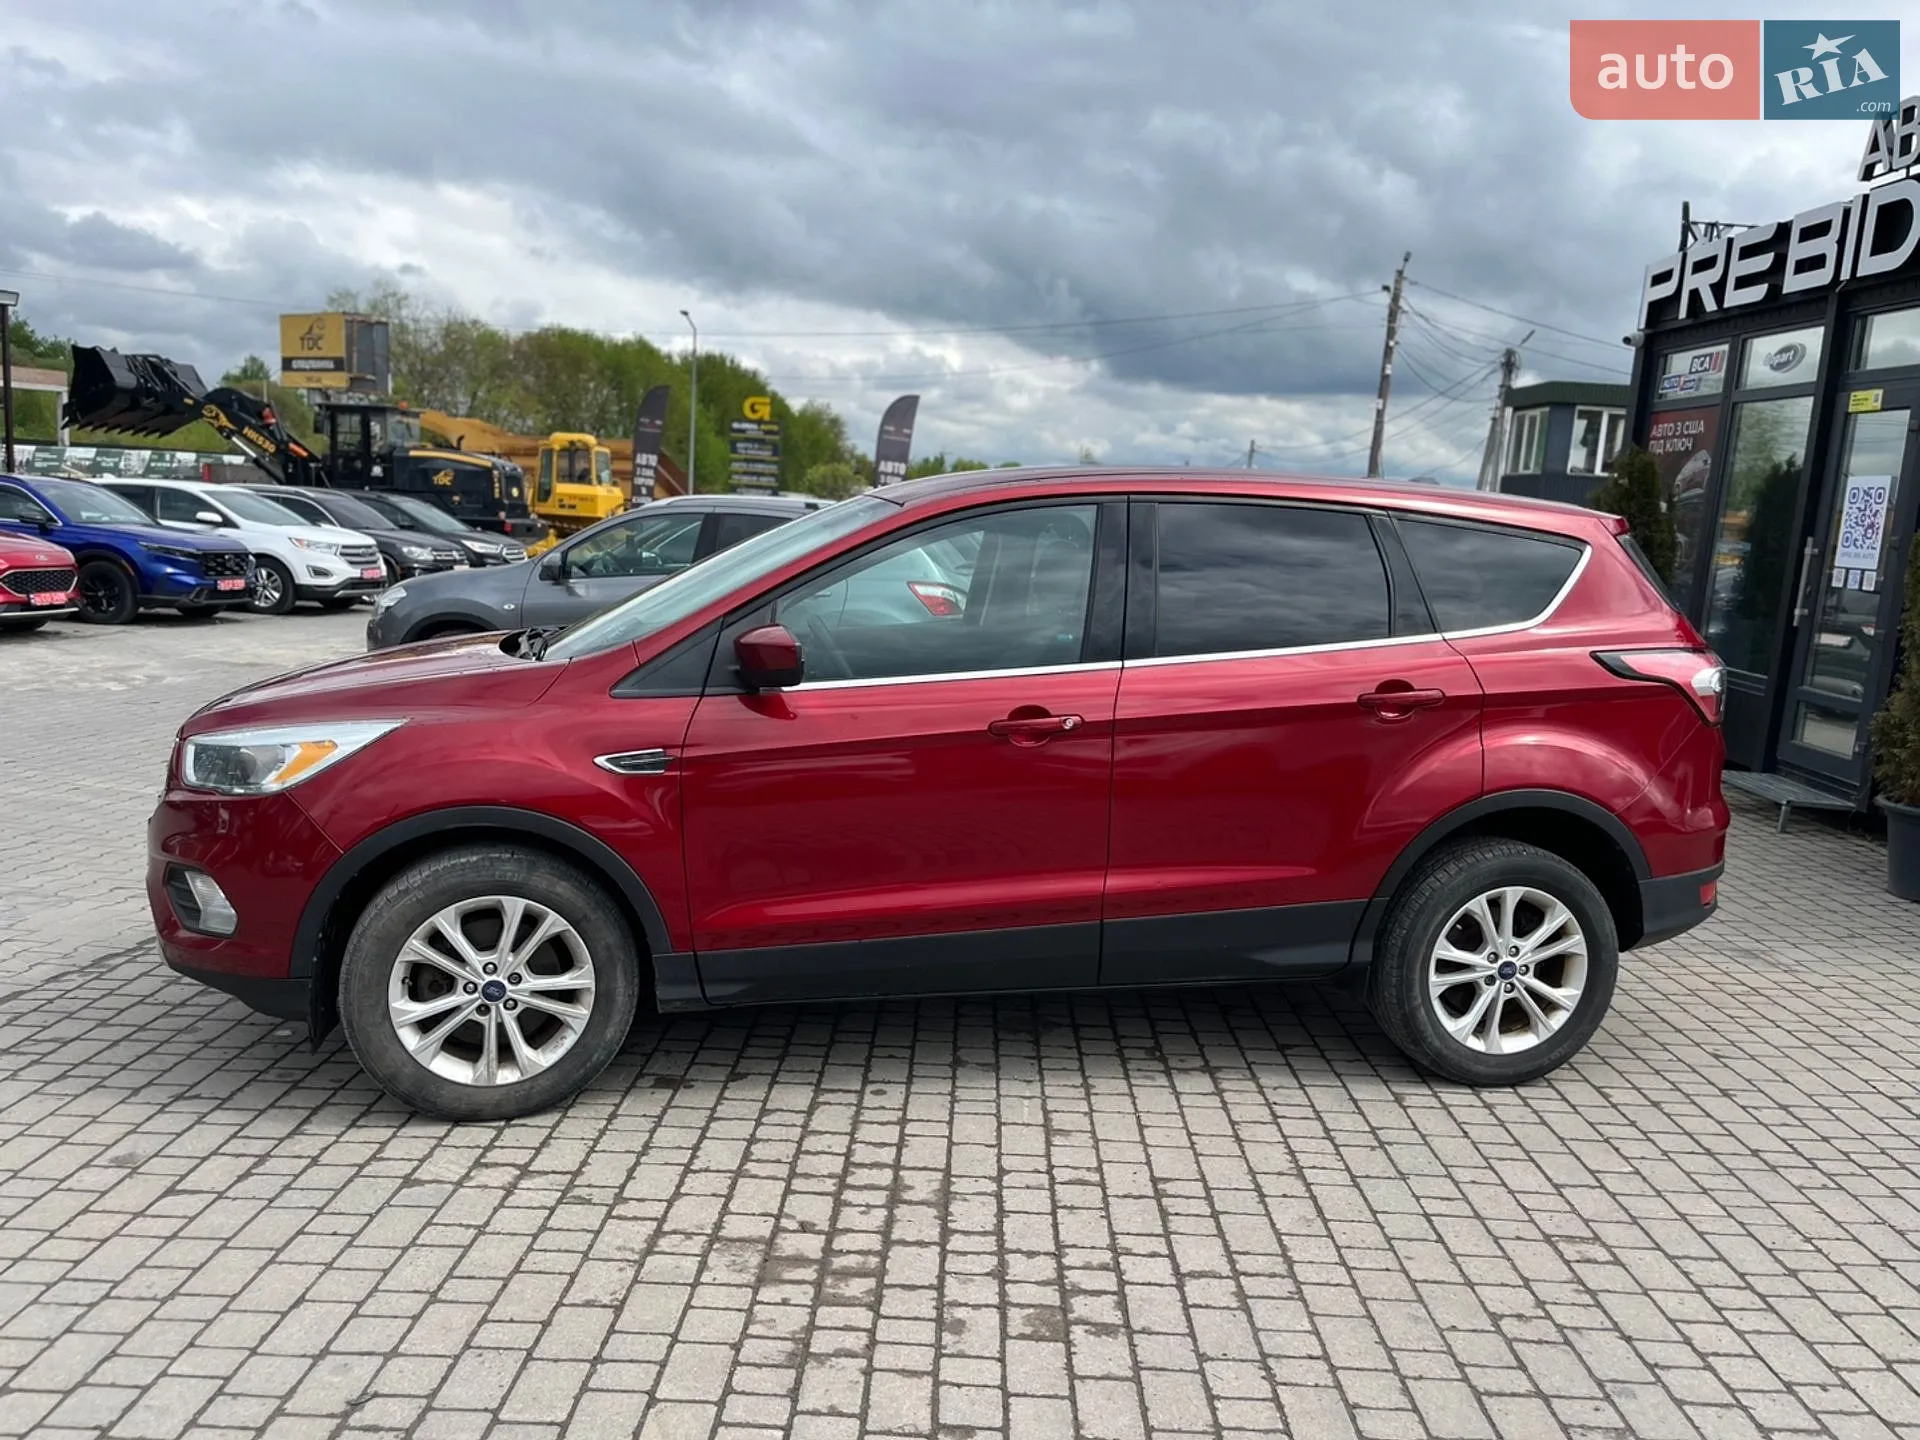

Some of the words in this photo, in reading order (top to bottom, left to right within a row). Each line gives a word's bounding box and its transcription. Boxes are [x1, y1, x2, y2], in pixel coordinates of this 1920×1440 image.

[1691, 356, 1710, 372] BCA
[1650, 425, 1674, 438] АВТО
[1683, 419, 1704, 434] США
